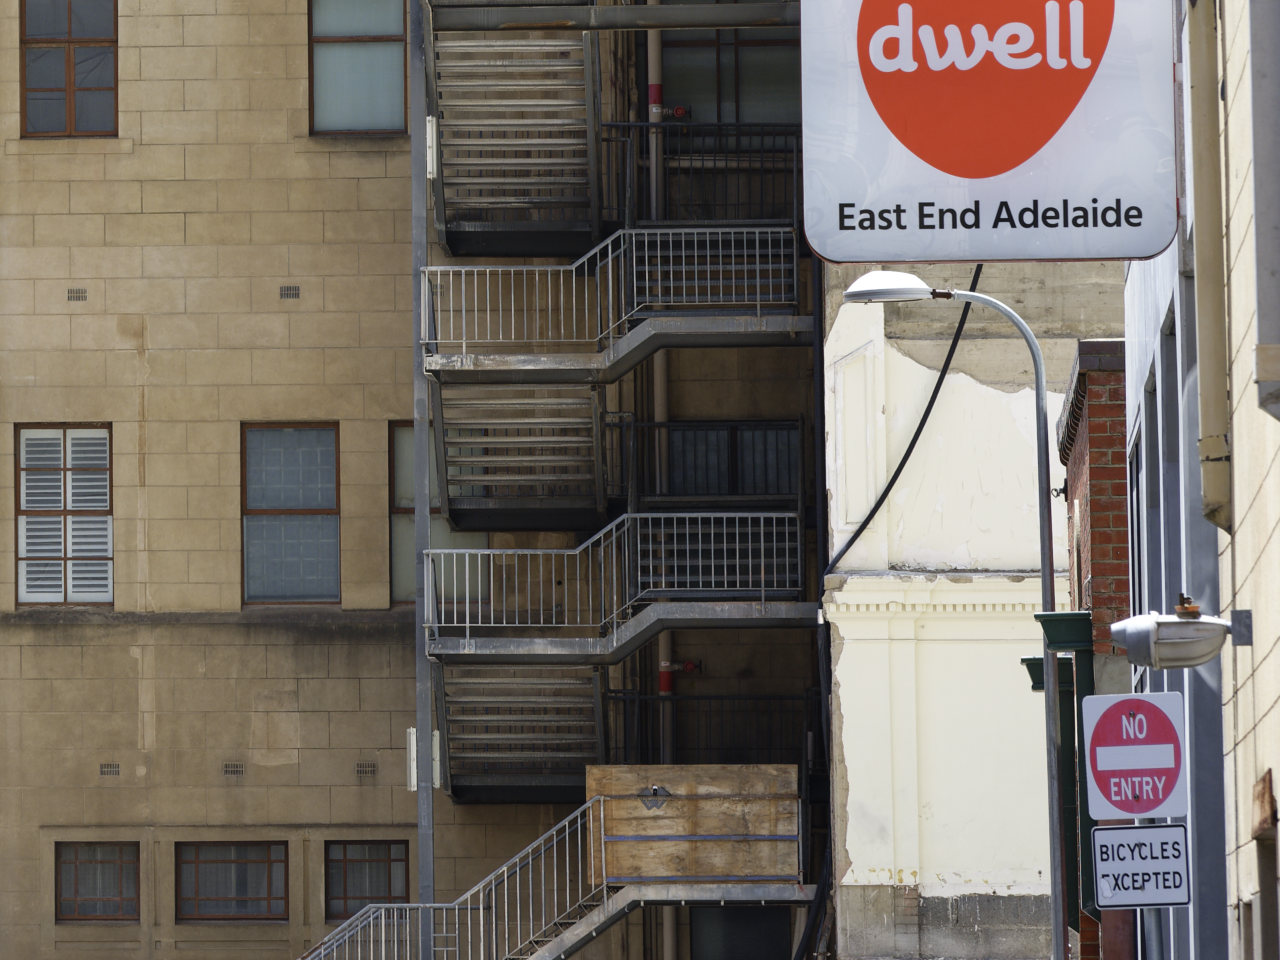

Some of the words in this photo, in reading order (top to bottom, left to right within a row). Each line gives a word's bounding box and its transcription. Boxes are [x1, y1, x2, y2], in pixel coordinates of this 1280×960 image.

[868, 0, 1092, 73] dwell
[838, 202, 907, 231] East
[917, 201, 981, 230] End
[992, 198, 1143, 229] Adelaide
[1122, 714, 1147, 739] NO
[1111, 776, 1166, 800] ENTRY
[1100, 841, 1181, 861] BICYCLES
[1102, 871, 1182, 891] XCEPTED
